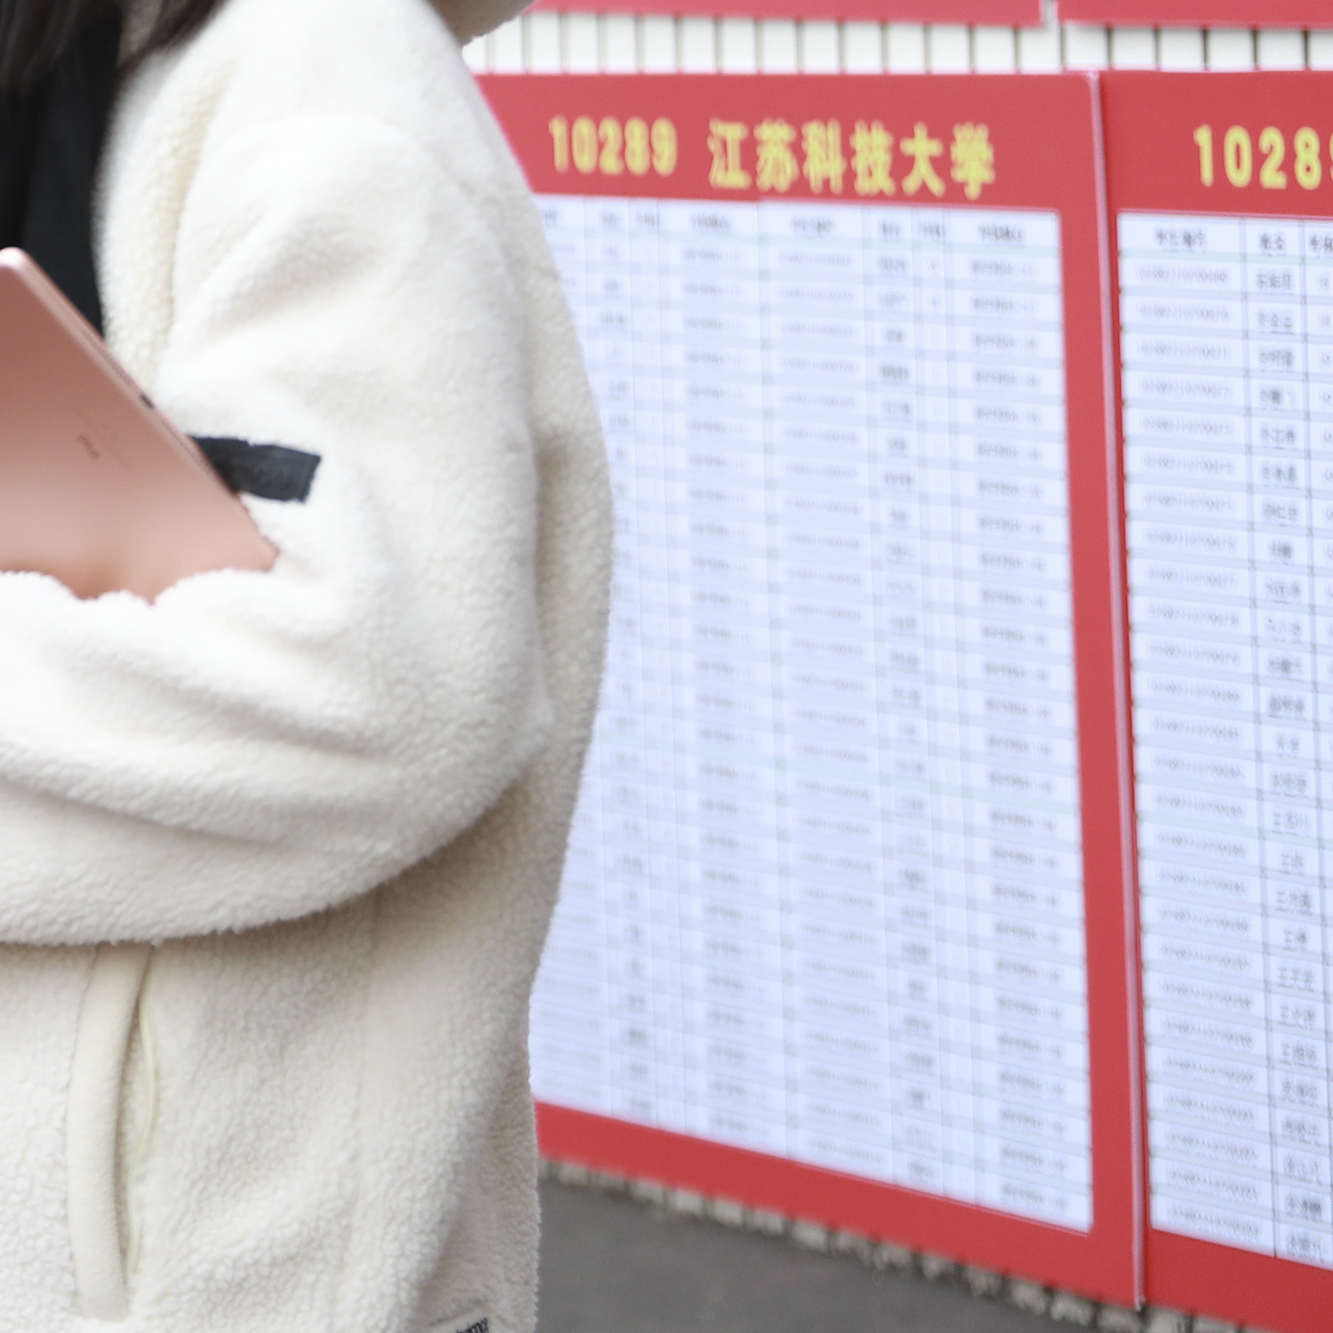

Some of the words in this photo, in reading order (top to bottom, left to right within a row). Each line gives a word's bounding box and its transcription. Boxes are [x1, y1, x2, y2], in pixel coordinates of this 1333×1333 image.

[549, 116, 678, 176] 10289
[709, 119, 997, 198] 江苏科技大学
[1193, 124, 1333, 190] 1028
